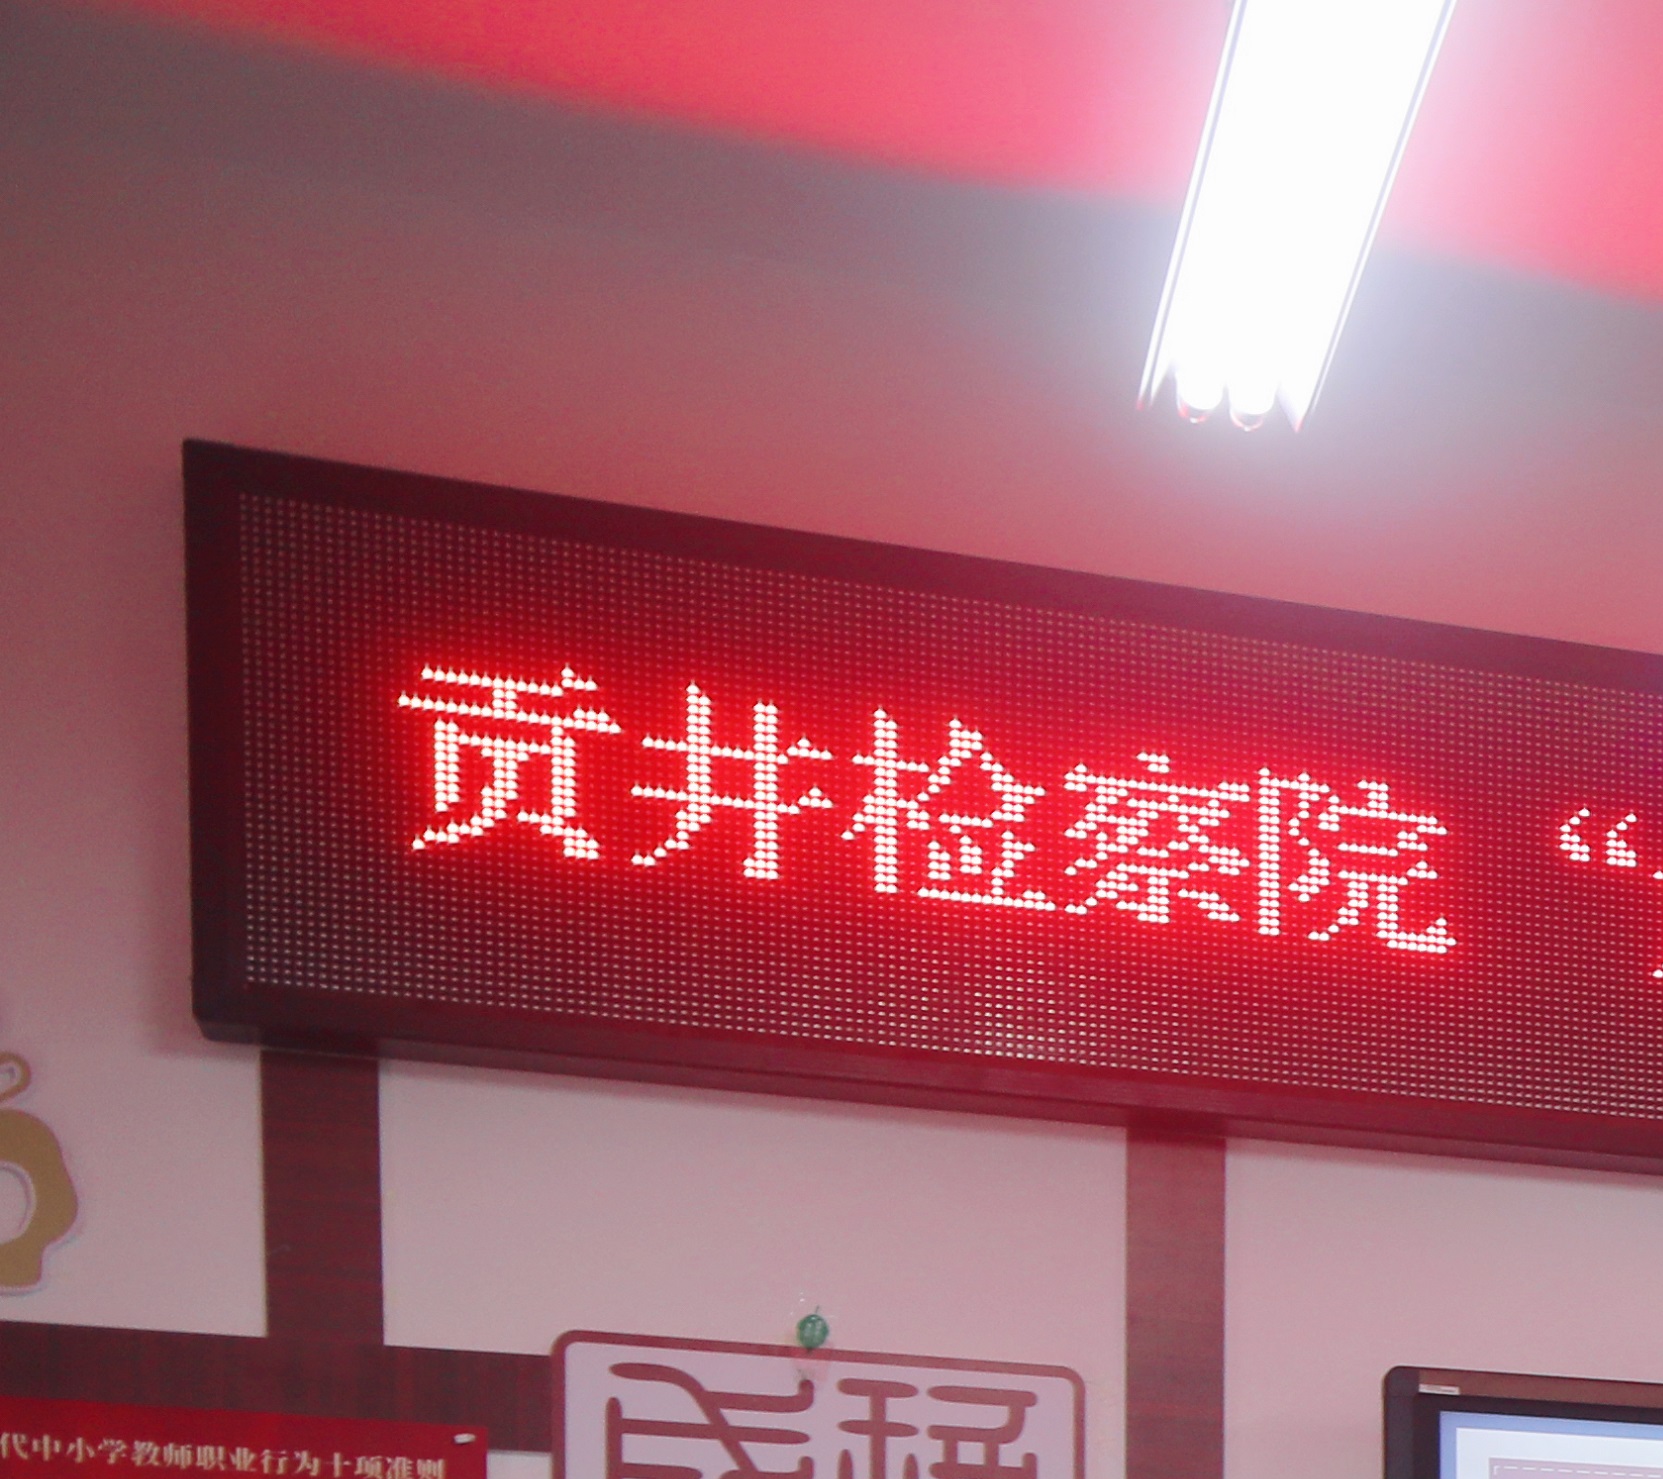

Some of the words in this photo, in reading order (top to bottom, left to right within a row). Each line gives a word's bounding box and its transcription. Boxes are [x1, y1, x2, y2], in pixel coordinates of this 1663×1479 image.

[397, 663, 1458, 953] 贡井检察院
